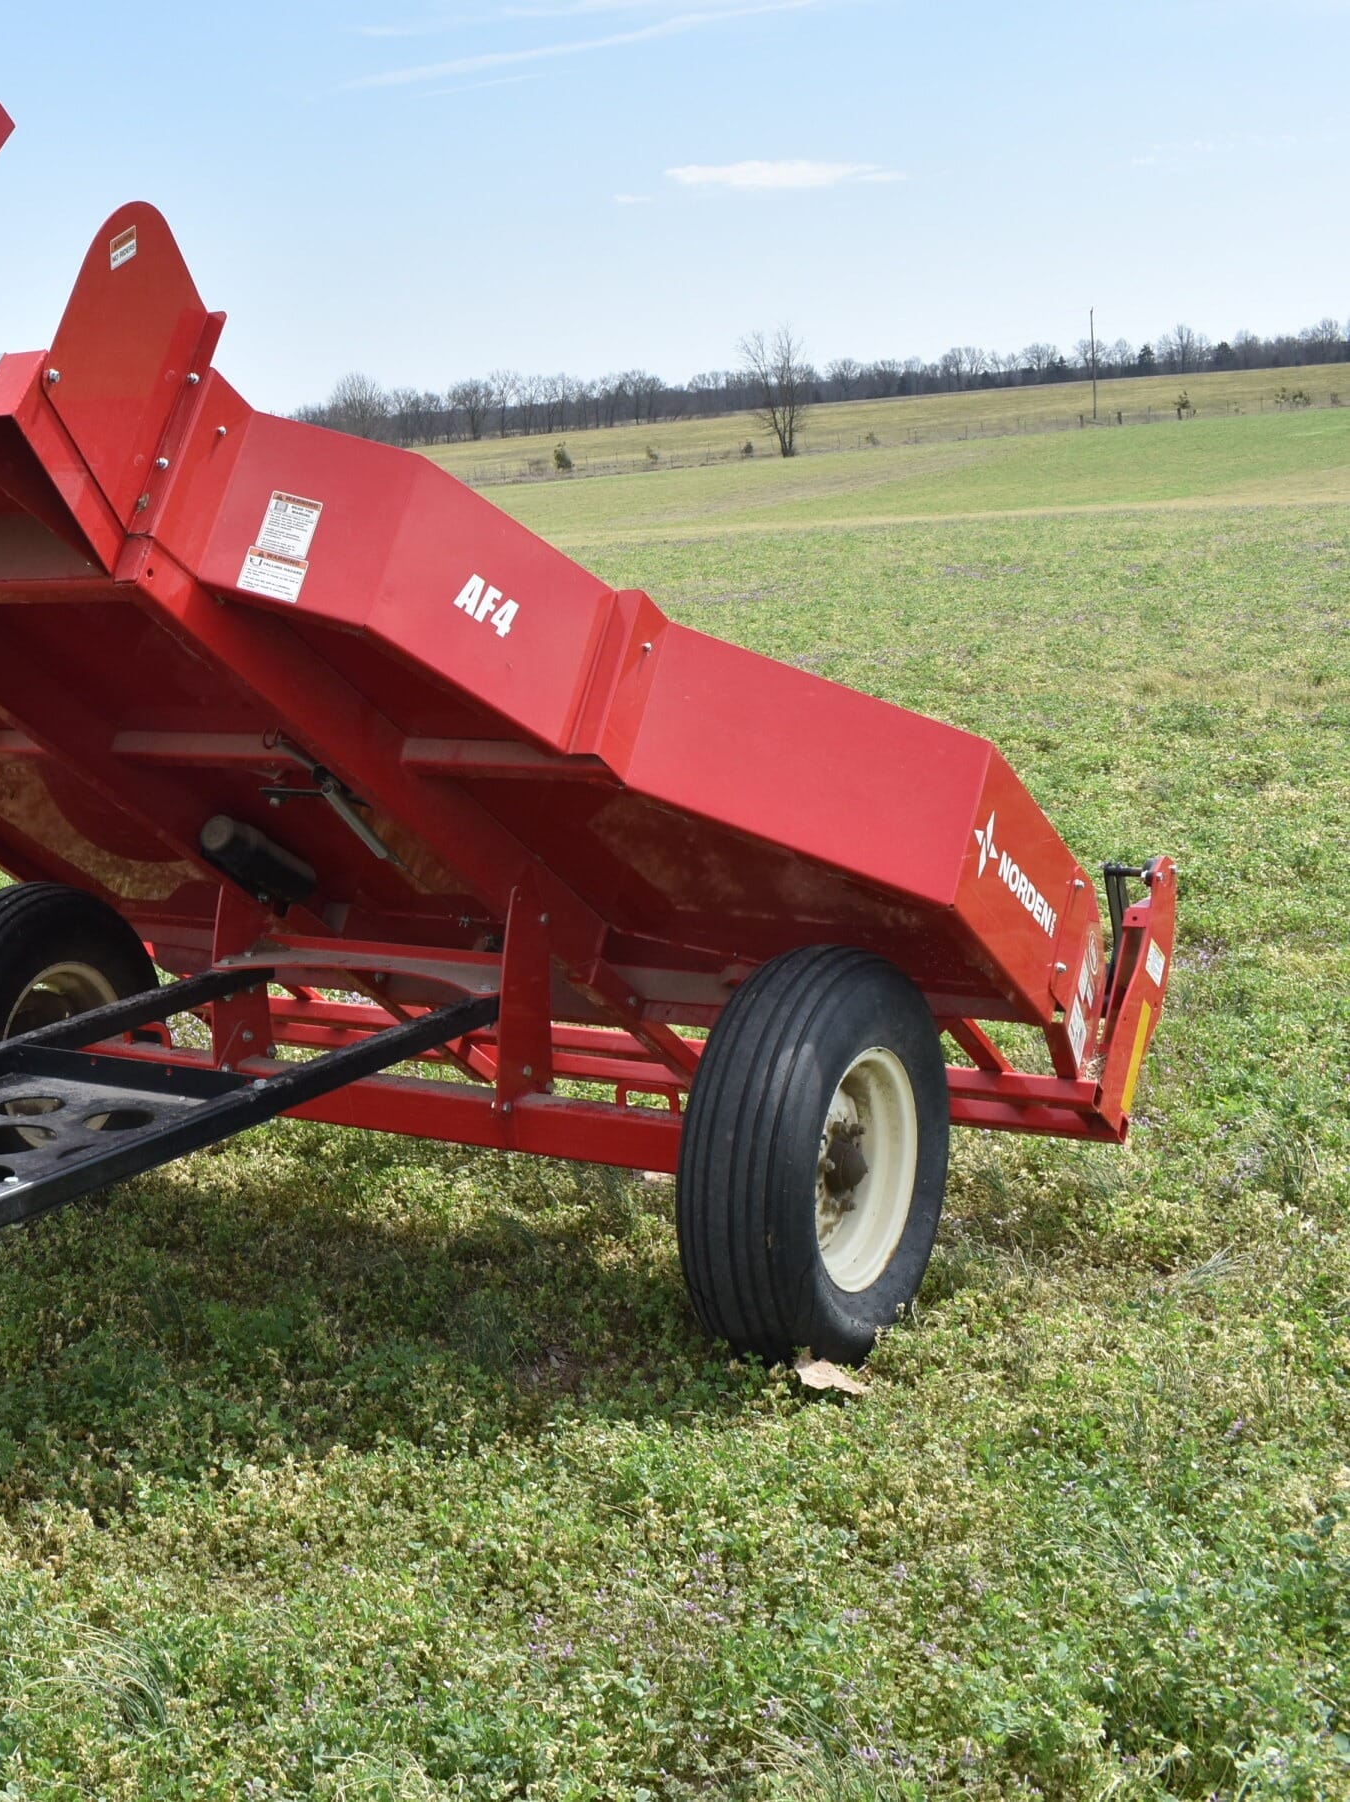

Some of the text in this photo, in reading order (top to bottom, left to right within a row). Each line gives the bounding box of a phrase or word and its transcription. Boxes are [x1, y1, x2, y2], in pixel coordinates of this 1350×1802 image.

[266, 551, 301, 566] WARNING
[283, 567, 303, 576] HAZARD
[453, 573, 519, 638] AF4
[998, 850, 1052, 933] NORDEN
